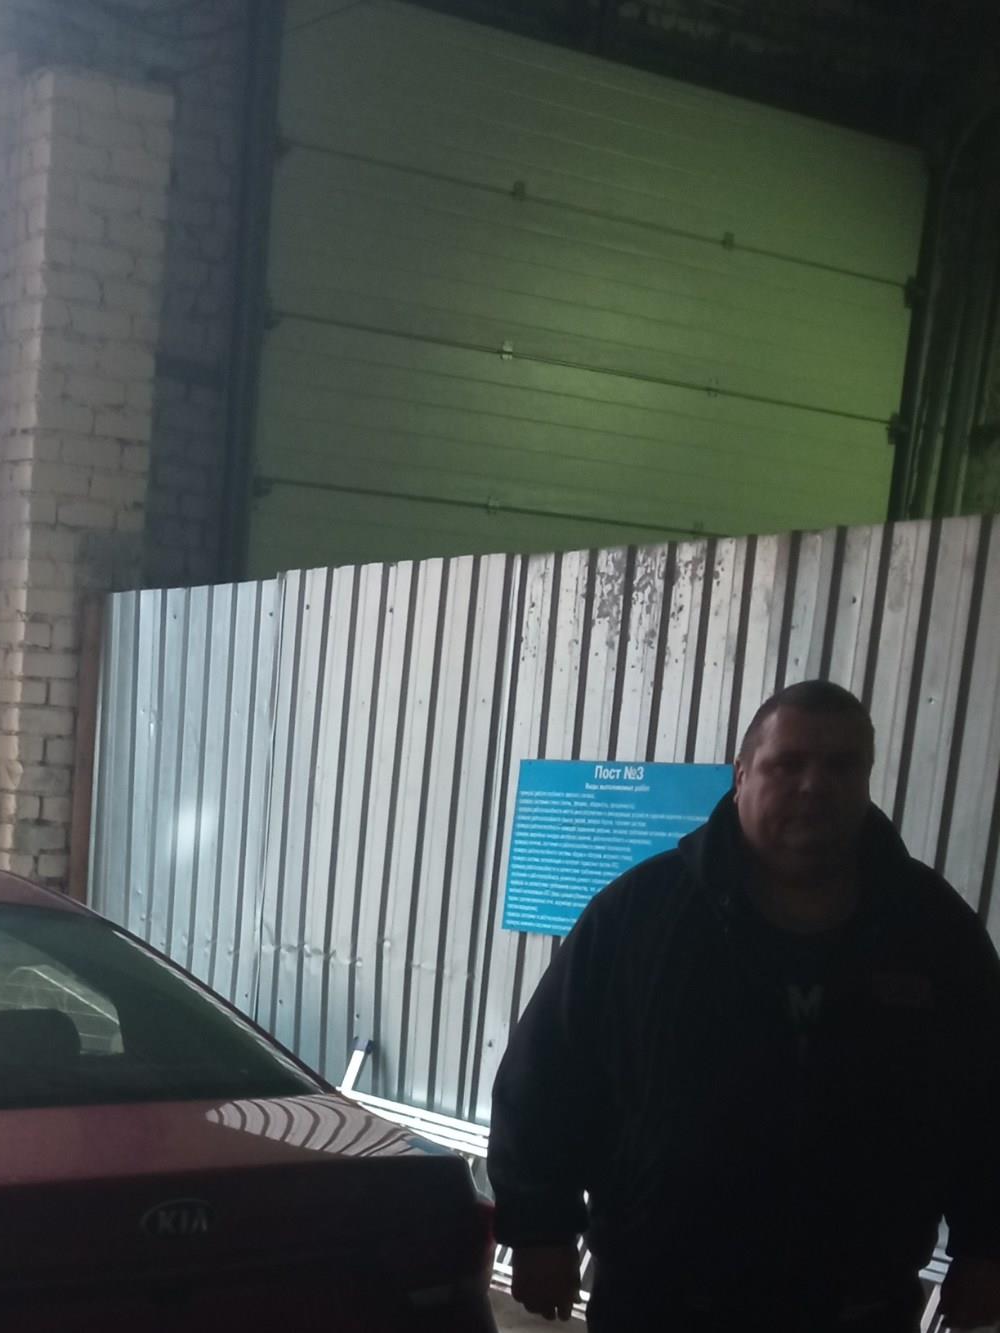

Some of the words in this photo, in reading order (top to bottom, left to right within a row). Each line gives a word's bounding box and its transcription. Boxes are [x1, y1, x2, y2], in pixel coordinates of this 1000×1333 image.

[594, 764, 622, 780] Пост
[623, 765, 645, 780] №3
[155, 1209, 209, 1233] KIA
